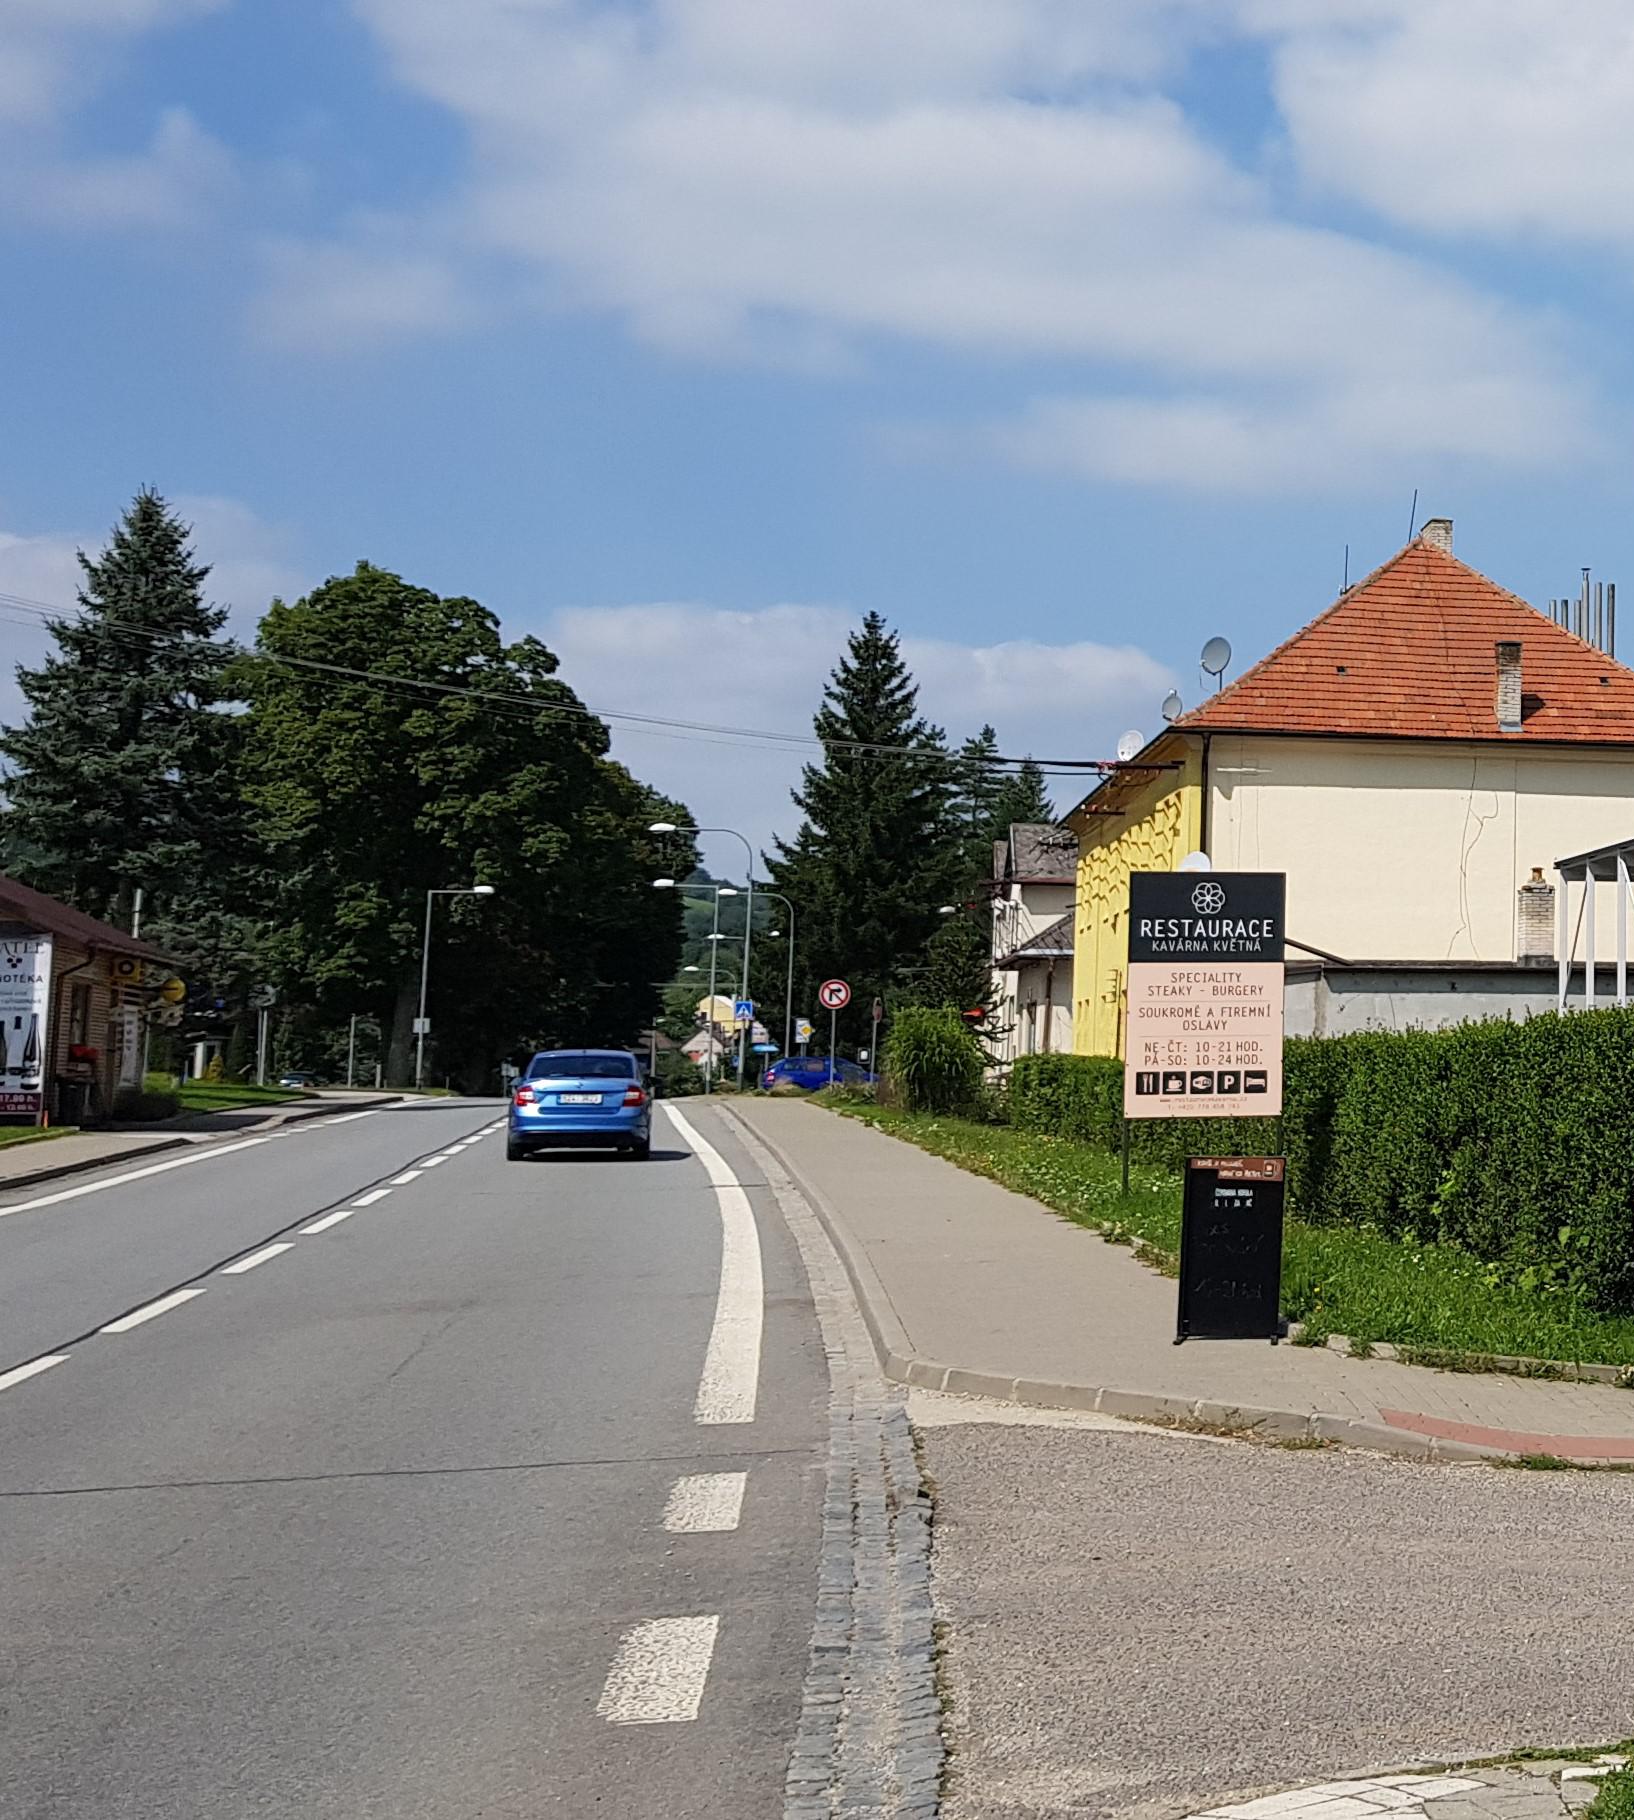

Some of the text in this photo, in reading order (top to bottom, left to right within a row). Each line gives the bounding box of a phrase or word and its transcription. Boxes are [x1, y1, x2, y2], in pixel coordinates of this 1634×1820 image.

[1140, 919, 1274, 938] RESTAURACE
[1152, 938, 1262, 952] KAVÁRNA KVĚTNÁ
[0, 973, 43, 983] OTÉKA
[1171, 972, 1242, 984] SPECIALITY
[1147, 985, 1192, 997] STEAKY
[1212, 985, 1264, 997] BURGERY
[1138, 1004, 1271, 1018] SOUKROMÉ A FIREMNÍ
[1182, 1020, 1228, 1031] OSLAVY
[1144, 1039, 1264, 1053] NE-ČT: 10-21 HOD.
[1144, 1053, 1264, 1066] PÁ-SO: 10-24 HOD.
[1224, 1075, 1235, 1089] P
